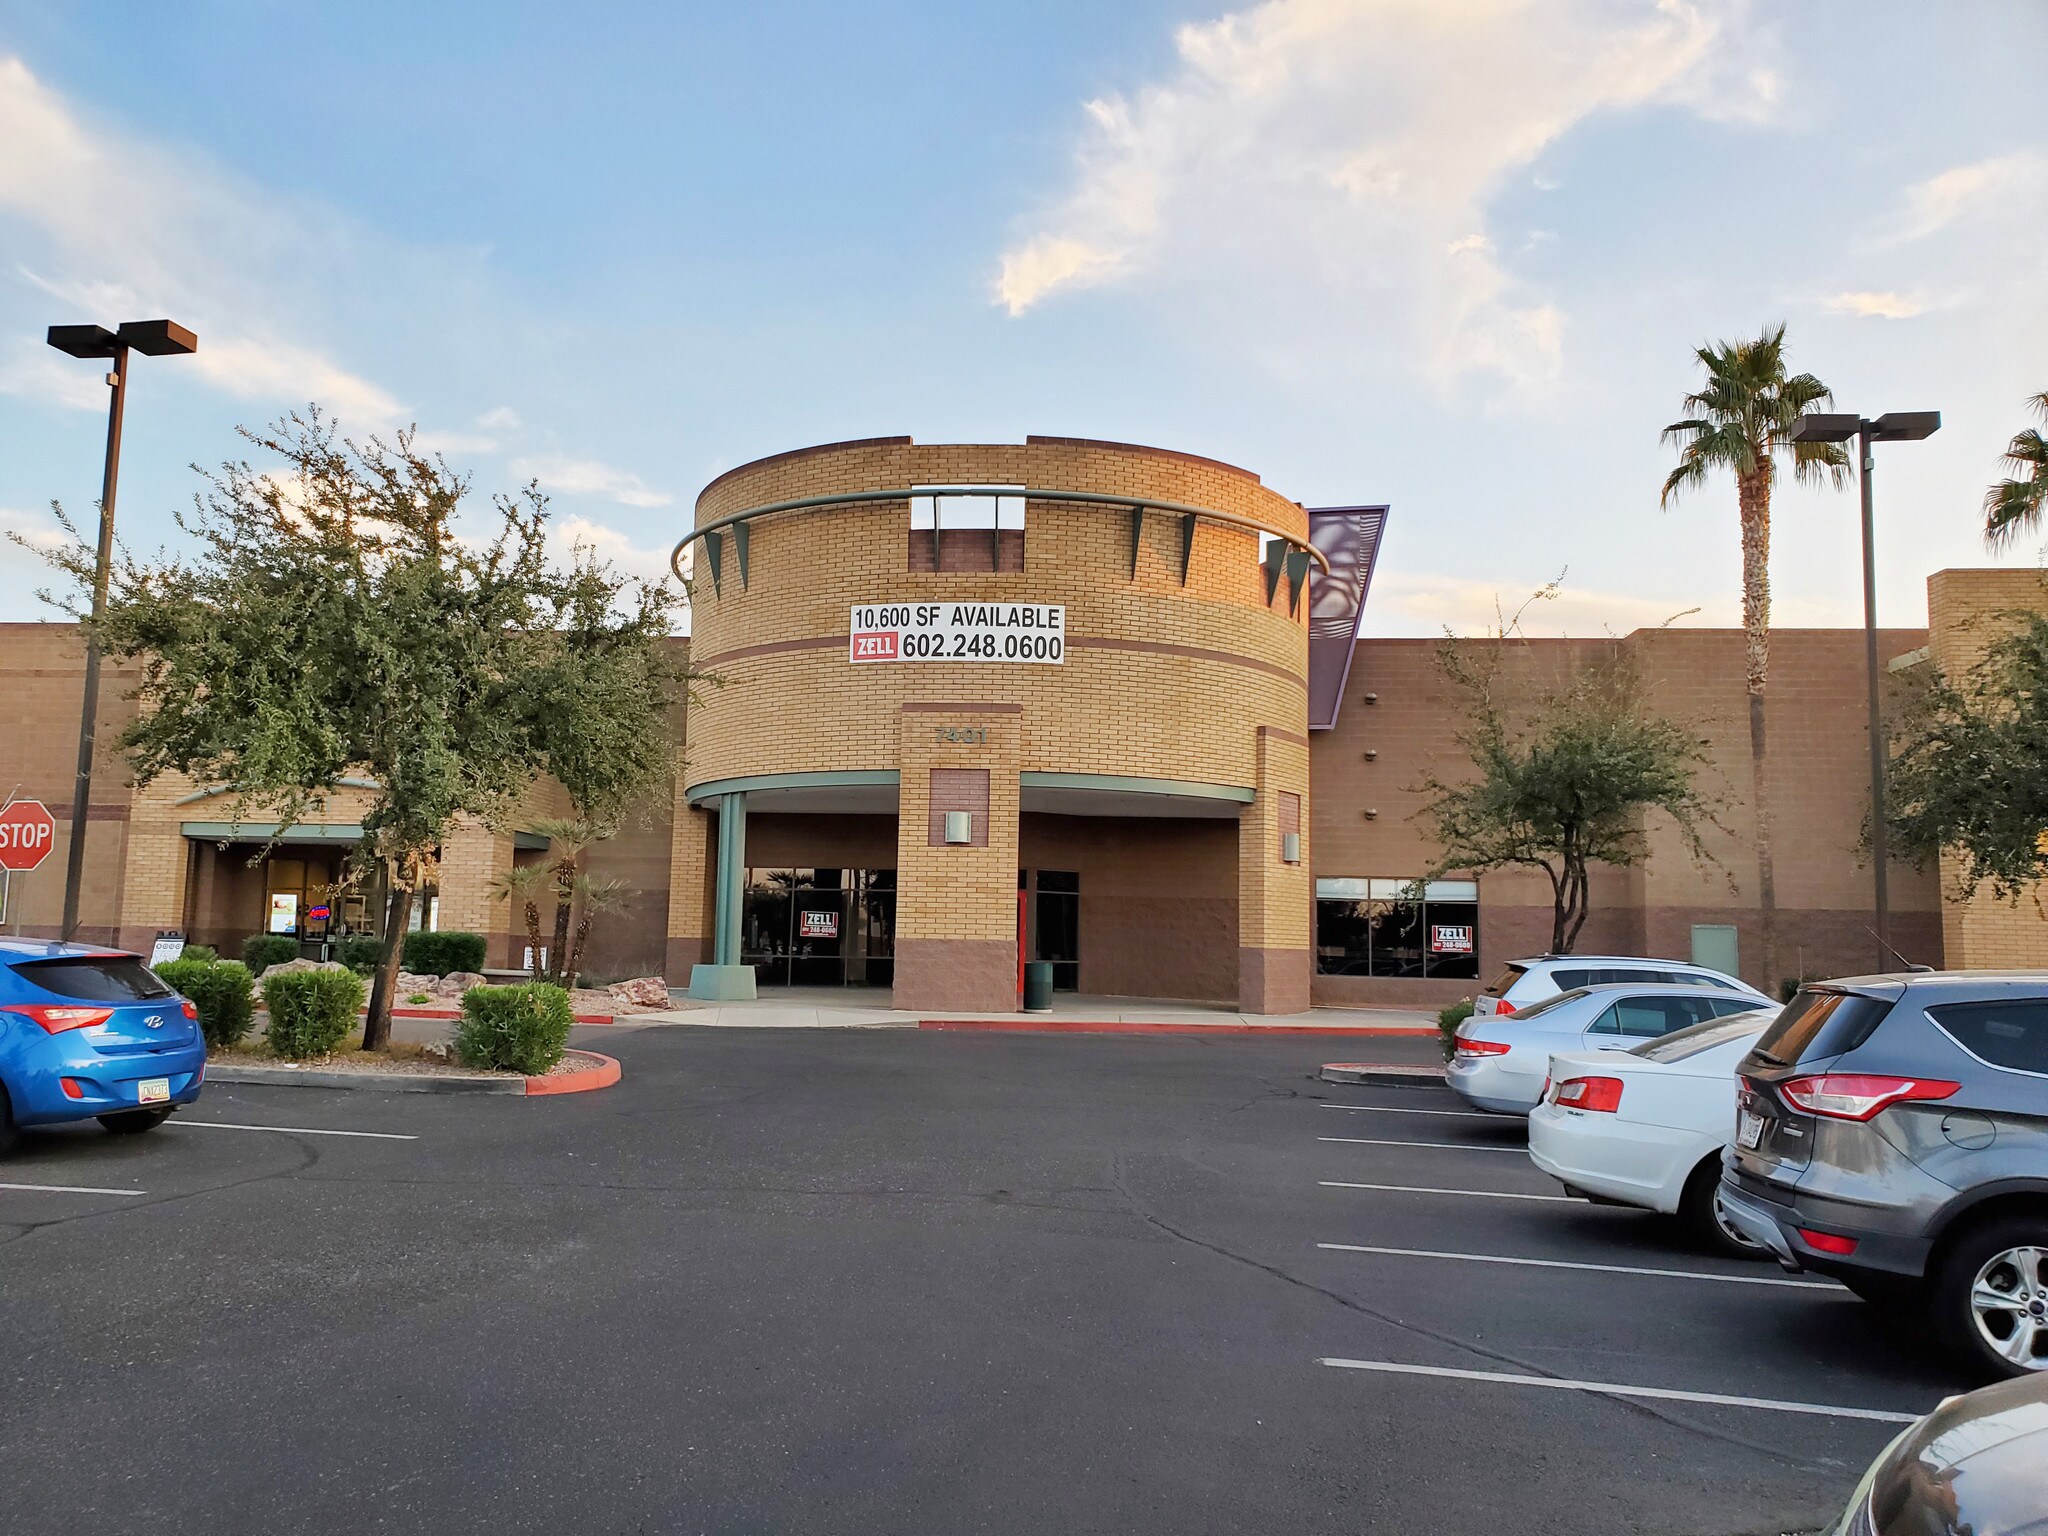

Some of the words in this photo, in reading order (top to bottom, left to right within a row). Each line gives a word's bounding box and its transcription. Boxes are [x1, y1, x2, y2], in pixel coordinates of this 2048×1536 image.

[855, 606, 910, 631] 10,600
[916, 606, 940, 627] SF
[951, 606, 1060, 629] AVAILABLE
[857, 637, 895, 656] ZELL
[903, 634, 1062, 660] 602.248.0600
[935, 727, 987, 744] 7401
[0, 823, 50, 848] STOP
[807, 913, 832, 925] ZELL
[1438, 928, 1465, 940] ZELL
